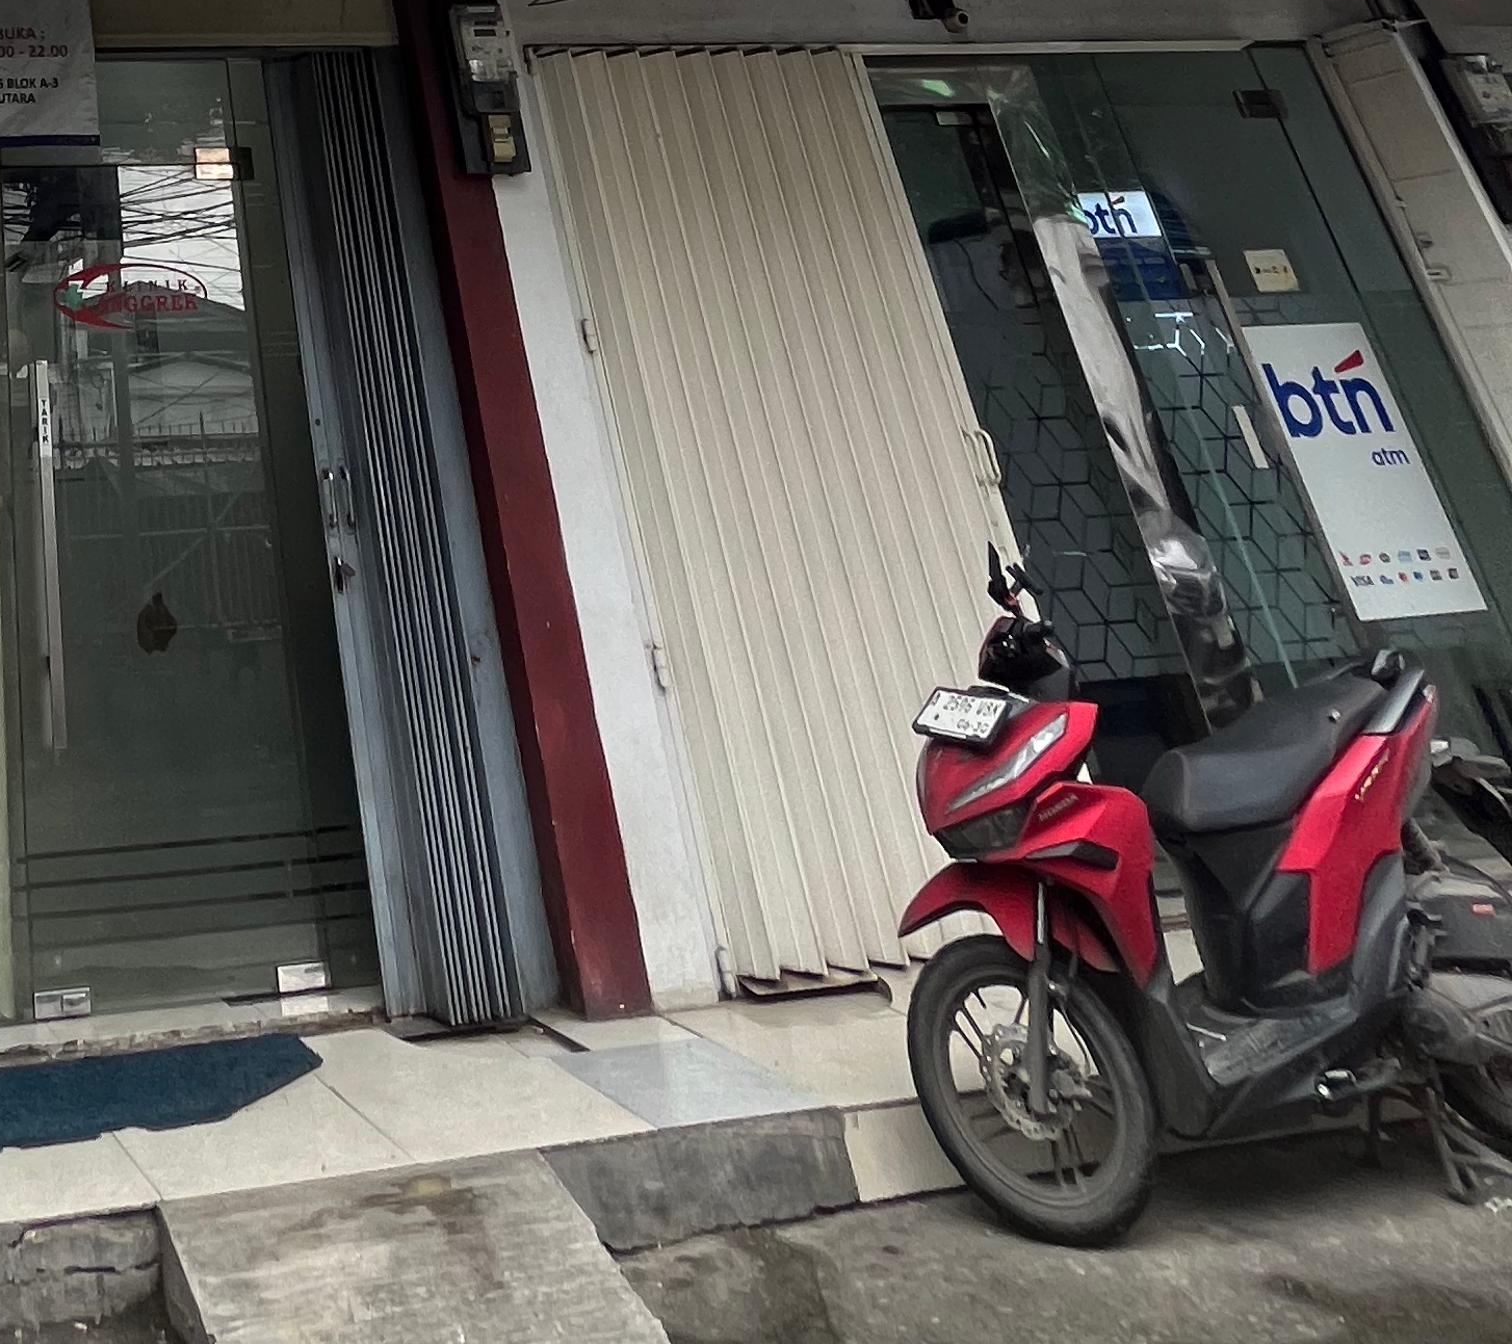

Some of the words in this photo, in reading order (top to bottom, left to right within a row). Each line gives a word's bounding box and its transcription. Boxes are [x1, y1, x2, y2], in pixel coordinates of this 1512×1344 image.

[28, 45, 68, 58] 22.00
[7, 78, 36, 89] BLOK
[40, 78, 59, 89] A-3
[1262, 350, 1394, 438] btn
[40, 399, 49, 443] TARIK
[1371, 448, 1411, 467] atm
